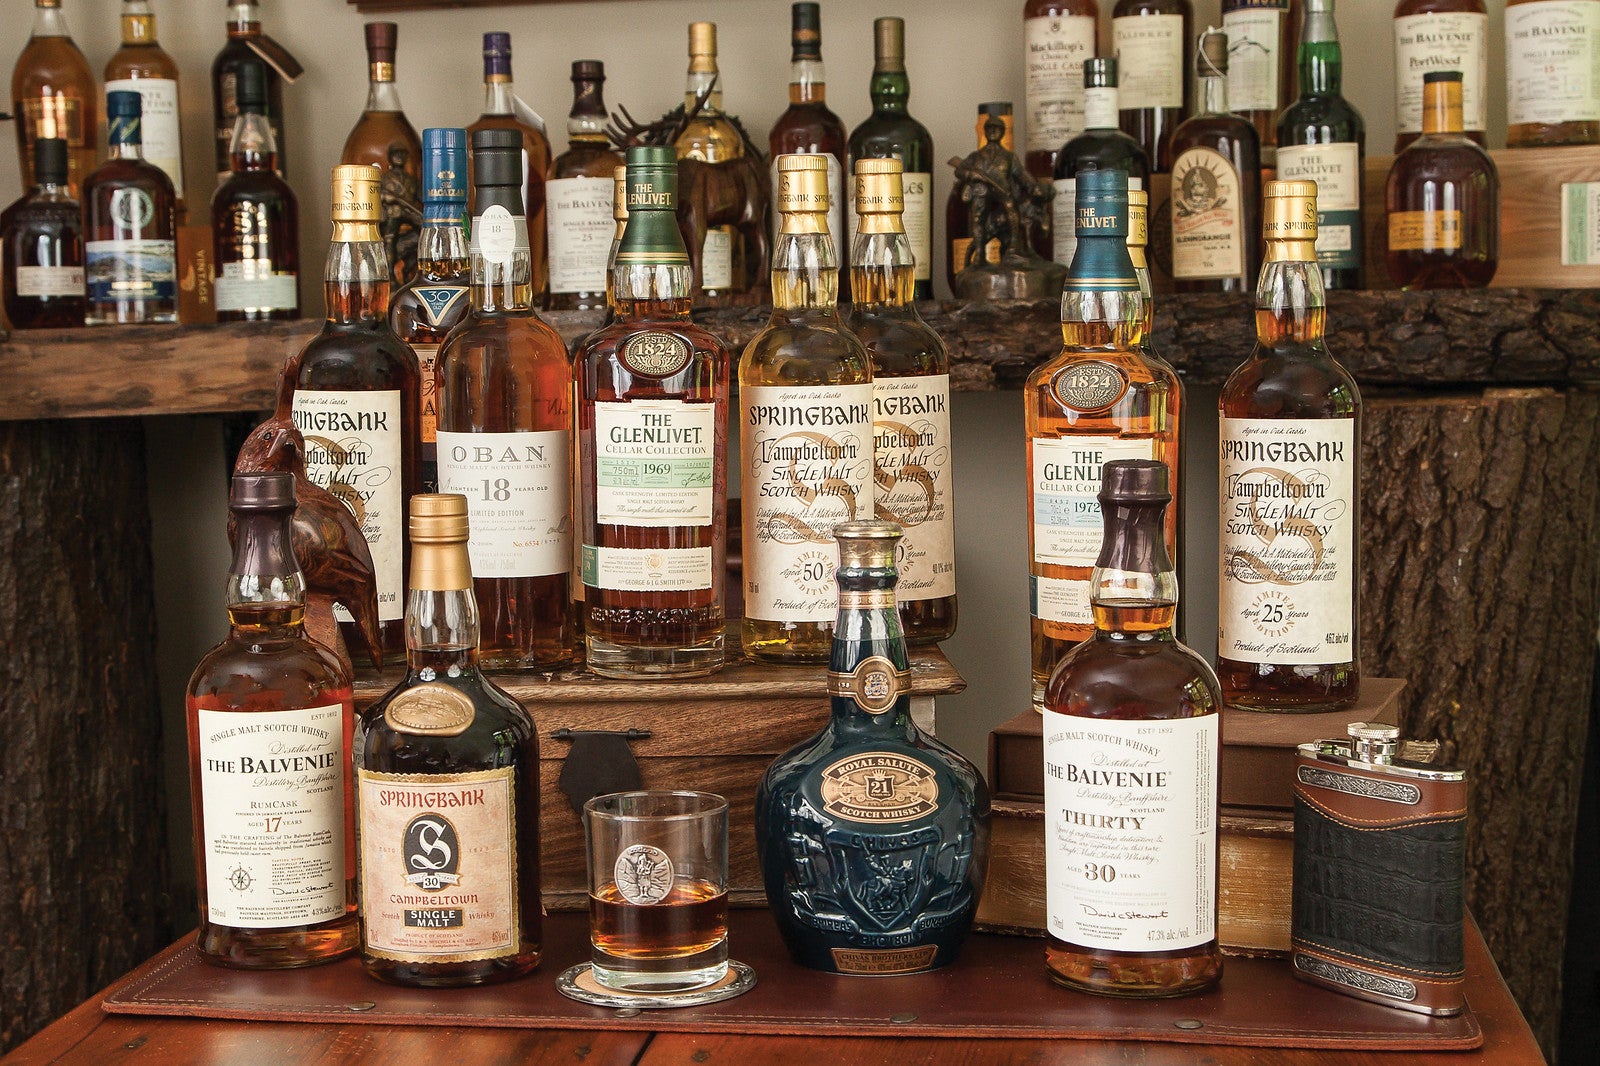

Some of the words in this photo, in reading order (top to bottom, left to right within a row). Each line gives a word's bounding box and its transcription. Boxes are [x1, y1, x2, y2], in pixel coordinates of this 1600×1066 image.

[1416, 33, 1471, 43] BALVENIE
[1531, 26, 1585, 36] BALVENIE
[1409, 56, 1460, 67] PortWood
[1301, 156, 1322, 164] THE
[1285, 164, 1341, 176] GLENLIVET
[635, 183, 652, 193] THE
[1079, 207, 1096, 217] THE
[490, 225, 502, 233] 18
[197, 249, 209, 304] VINTAGE
[427, 290, 450, 301] 30
[645, 336, 668, 344] ESTD
[637, 343, 677, 356] 1824
[1079, 368, 1103, 376] ESTD
[1070, 375, 1112, 388] 1824
[779, 392, 796, 402] Aged
[873, 393, 945, 417] NGBANK
[292, 411, 388, 432] RINGBANK
[642, 414, 672, 427] THE
[750, 404, 869, 426] SPRINGBANK
[1242, 426, 1259, 436] Aged
[1270, 427, 1285, 435] Oak
[451, 446, 544, 463] OBAN
[605, 444, 642, 454] CELLAR
[645, 445, 706, 455] COLLECTION
[761, 432, 858, 465] Campbeltown
[1221, 440, 1344, 462] SPRINGBANK
[901, 449, 932, 467] MALT
[1072, 451, 1103, 464] THE
[327, 466, 360, 485] MALT
[613, 466, 639, 475] 750ml
[643, 463, 671, 475] 1969
[771, 463, 819, 484] SINGLE
[819, 464, 853, 481] MALT
[893, 470, 940, 485] WHISKY
[481, 478, 511, 501] 18
[760, 482, 809, 497] SCOTCH
[814, 483, 862, 500] WHISKY
[1040, 481, 1073, 492] CELLAR
[1225, 471, 1326, 503] Campbeltown
[1074, 502, 1101, 513] 1972
[1235, 500, 1280, 522] SINGLE
[1279, 501, 1321, 520] MALT
[1226, 519, 1269, 536] SCOTCH
[1274, 521, 1332, 542] WHISKY
[793, 550, 834, 569] LIMITED
[779, 568, 801, 578] Aged
[802, 562, 824, 582] 50
[900, 577, 935, 590] Scotland
[772, 598, 807, 610] Product
[808, 600, 819, 614] of
[1252, 590, 1296, 611] LIMITED
[1061, 610, 1081, 619] GEORGE
[1240, 608, 1260, 619] Aged
[1261, 603, 1283, 623] 25
[1285, 610, 1309, 620] Years
[1252, 617, 1296, 637] EDITION
[1233, 640, 1264, 652] Product
[1264, 643, 1279, 657] of
[1276, 642, 1321, 653] Scotland
[210, 728, 235, 744] SINGLE
[237, 724, 261, 735] MALT
[263, 724, 298, 732] SCOTCH
[300, 725, 330, 740] WHISKY
[268, 741, 311, 755] Distilled
[1048, 732, 1065, 746] SINGLE
[1065, 731, 1084, 741] MALT
[1087, 731, 1121, 746] SCOTCH
[1125, 738, 1161, 757] WHISKY
[206, 758, 235, 774] THE
[240, 752, 335, 774] BALVENIE
[838, 758, 876, 775] ROYAL
[877, 758, 921, 775] SALUTE
[1091, 751, 1140, 768] Distilled
[296, 773, 340, 790] Banffshire
[1046, 761, 1063, 780] THE
[1067, 764, 1167, 788] BALVENIE
[306, 785, 334, 795] SCOTLAND
[870, 781, 890, 794] 21
[380, 789, 485, 808] SPRINGBANK
[1117, 791, 1175, 809] Banffshire
[840, 805, 881, 818] SCOTCH
[882, 805, 922, 818] WHISKY
[264, 816, 283, 833] 17
[282, 819, 303, 827] YEARS
[1062, 809, 1146, 830] THIRTY
[851, 833, 919, 847] CHIVAS
[1121, 834, 1154, 843] dedication
[1091, 842, 1118, 851] captured
[1098, 852, 1122, 860] Scotch
[1066, 865, 1082, 873] AGED
[1084, 862, 1116, 883] 30
[268, 887, 299, 896] David
[305, 882, 334, 893] Stewart
[424, 877, 438, 887] 30
[390, 894, 479, 905] CAMPBELTOWN
[381, 911, 400, 921] Scotch
[411, 910, 456, 919] SINGLE
[468, 911, 495, 920] Whisky
[417, 918, 450, 927] MALT
[1125, 911, 1169, 920] Stewart
[1147, 930, 1165, 942] 47.3%
[871, 953, 913, 961] BROTHERS
